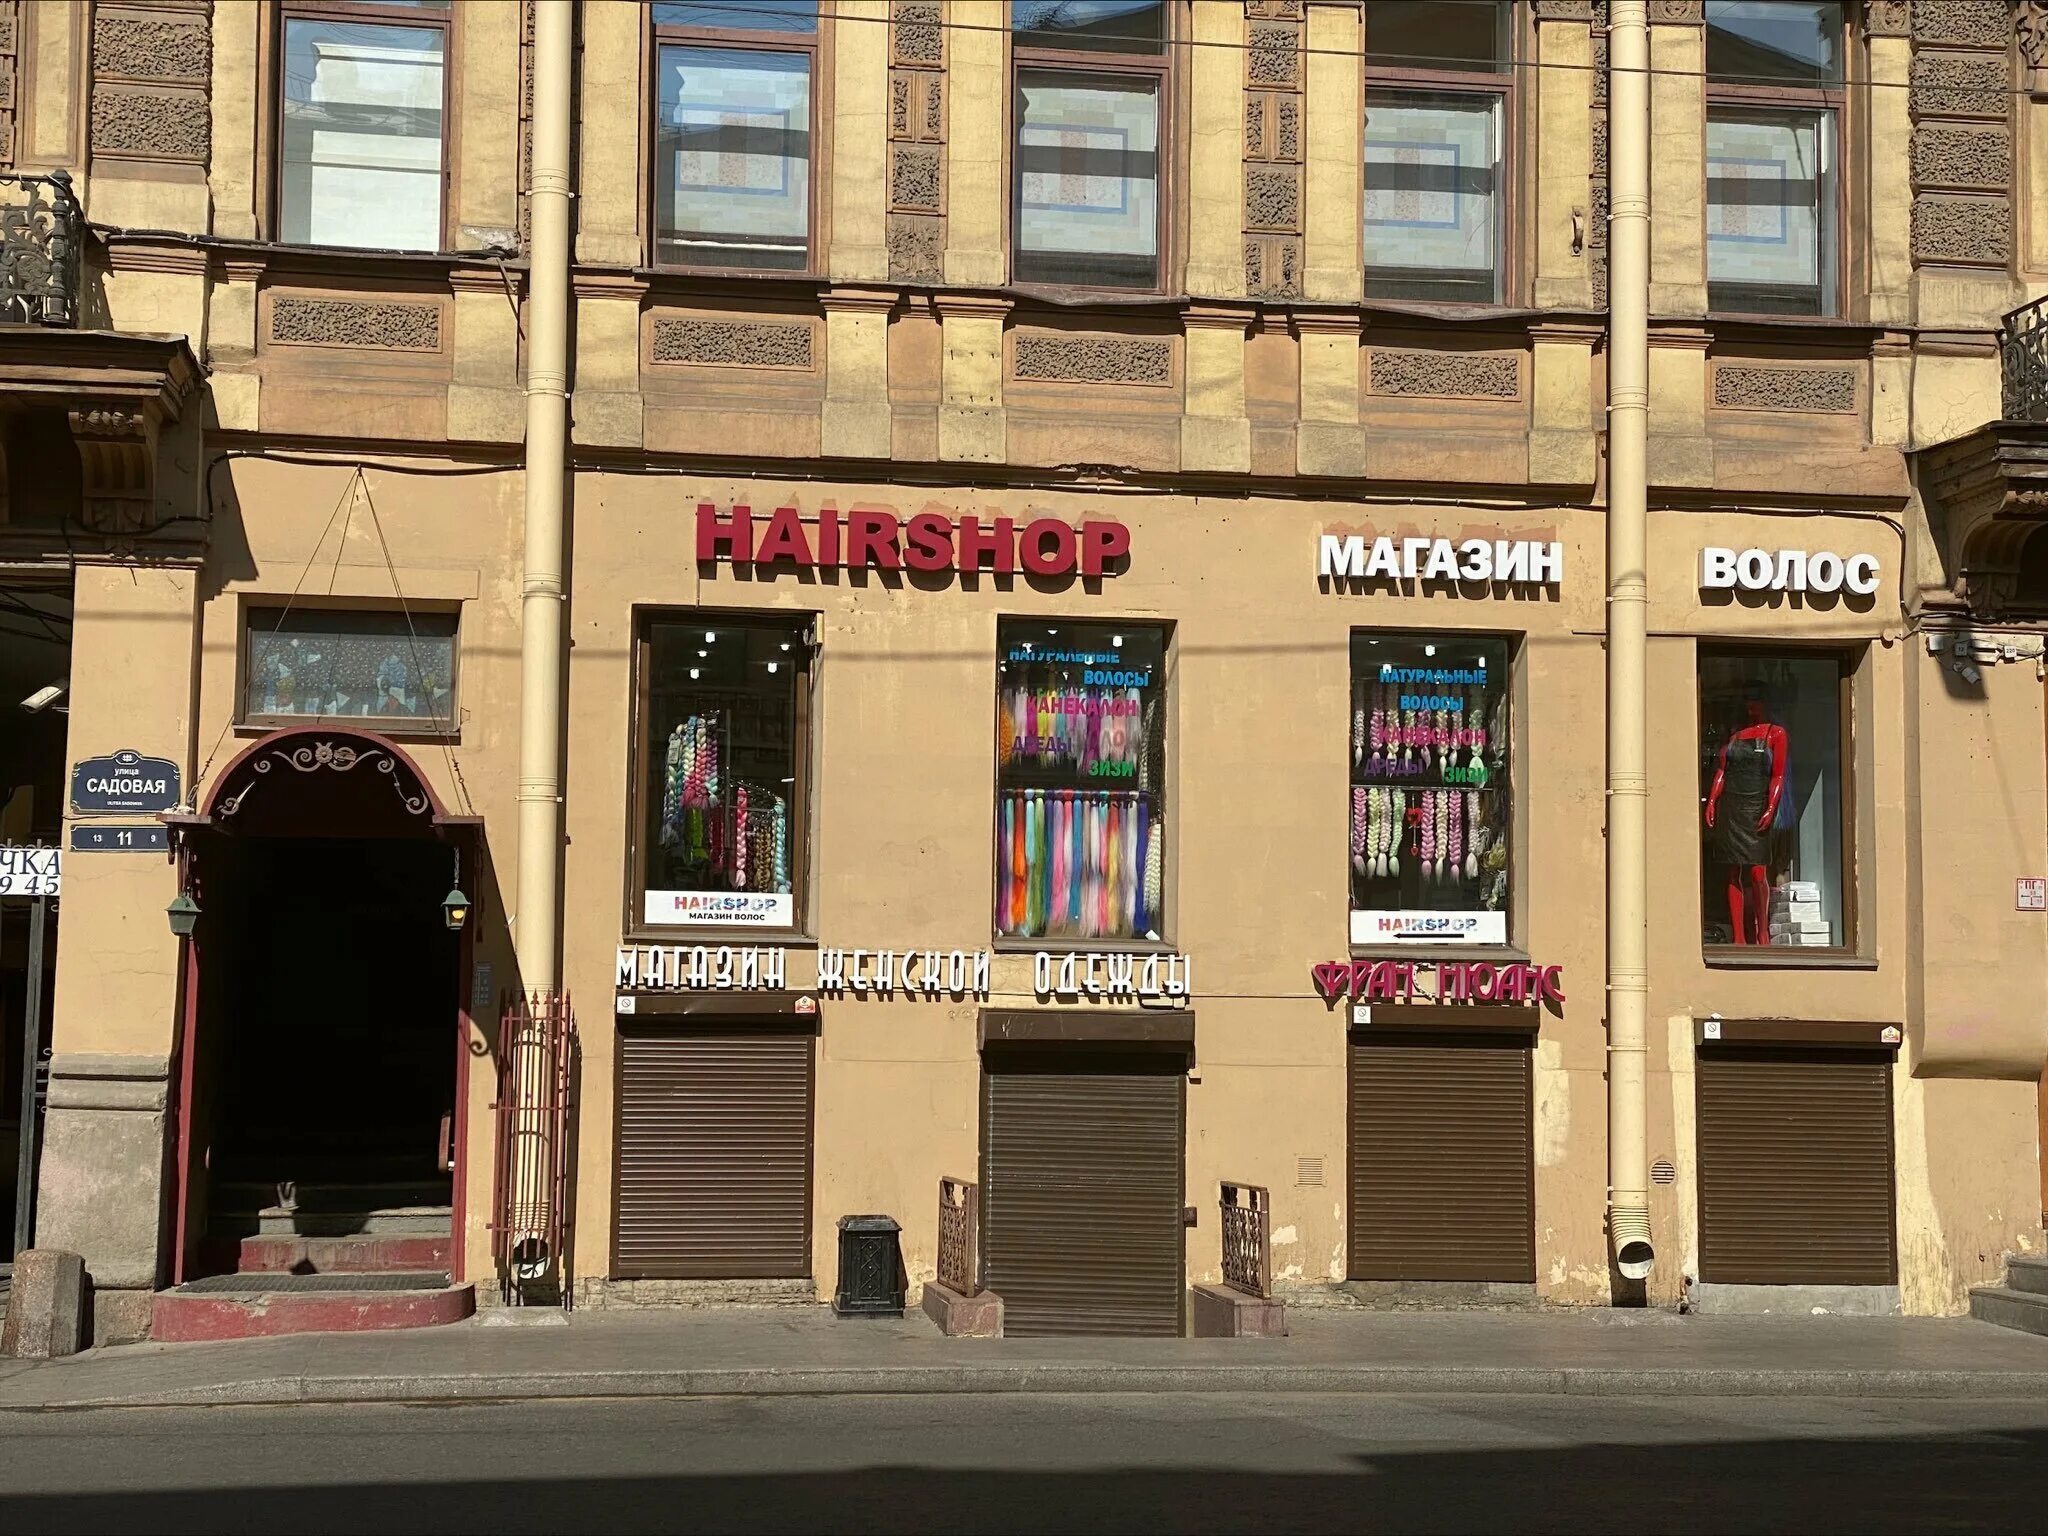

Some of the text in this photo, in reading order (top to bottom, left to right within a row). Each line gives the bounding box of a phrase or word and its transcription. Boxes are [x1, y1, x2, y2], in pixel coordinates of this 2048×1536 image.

[697, 504, 1130, 577] HAIRSHOP
[1319, 535, 1881, 595] МАГАЗИН ВОЛОС
[1084, 670, 1149, 687] ВОЛОСЫ
[1379, 669, 1488, 684] НАТУРАЛЬНЫЕ
[1026, 696, 1138, 716] КАНЕКАЛОН
[1400, 695, 1464, 711] ВОЛОСЫ
[1379, 726, 1487, 746] КАНЕКАЛОН
[114, 768, 139, 776] улица
[1088, 760, 1134, 777] ЗИЗИ
[1363, 758, 1424, 777] ДРЕДЫ
[1444, 766, 1489, 783] ЗИЗИ
[86, 778, 166, 796] САДОВАЯ
[93, 831, 156, 846] 13 11 9
[674, 896, 777, 912] HAIRSHOP
[689, 912, 765, 921] МАГАЗИН ВОЛОС
[1378, 918, 1478, 932] HAIRSHOP
[616, 944, 1191, 997] МАГАЗИН ЖЕНСКОЙ ОДЕЖДЫ
[1435, 962, 1566, 1003] НЮАНС
